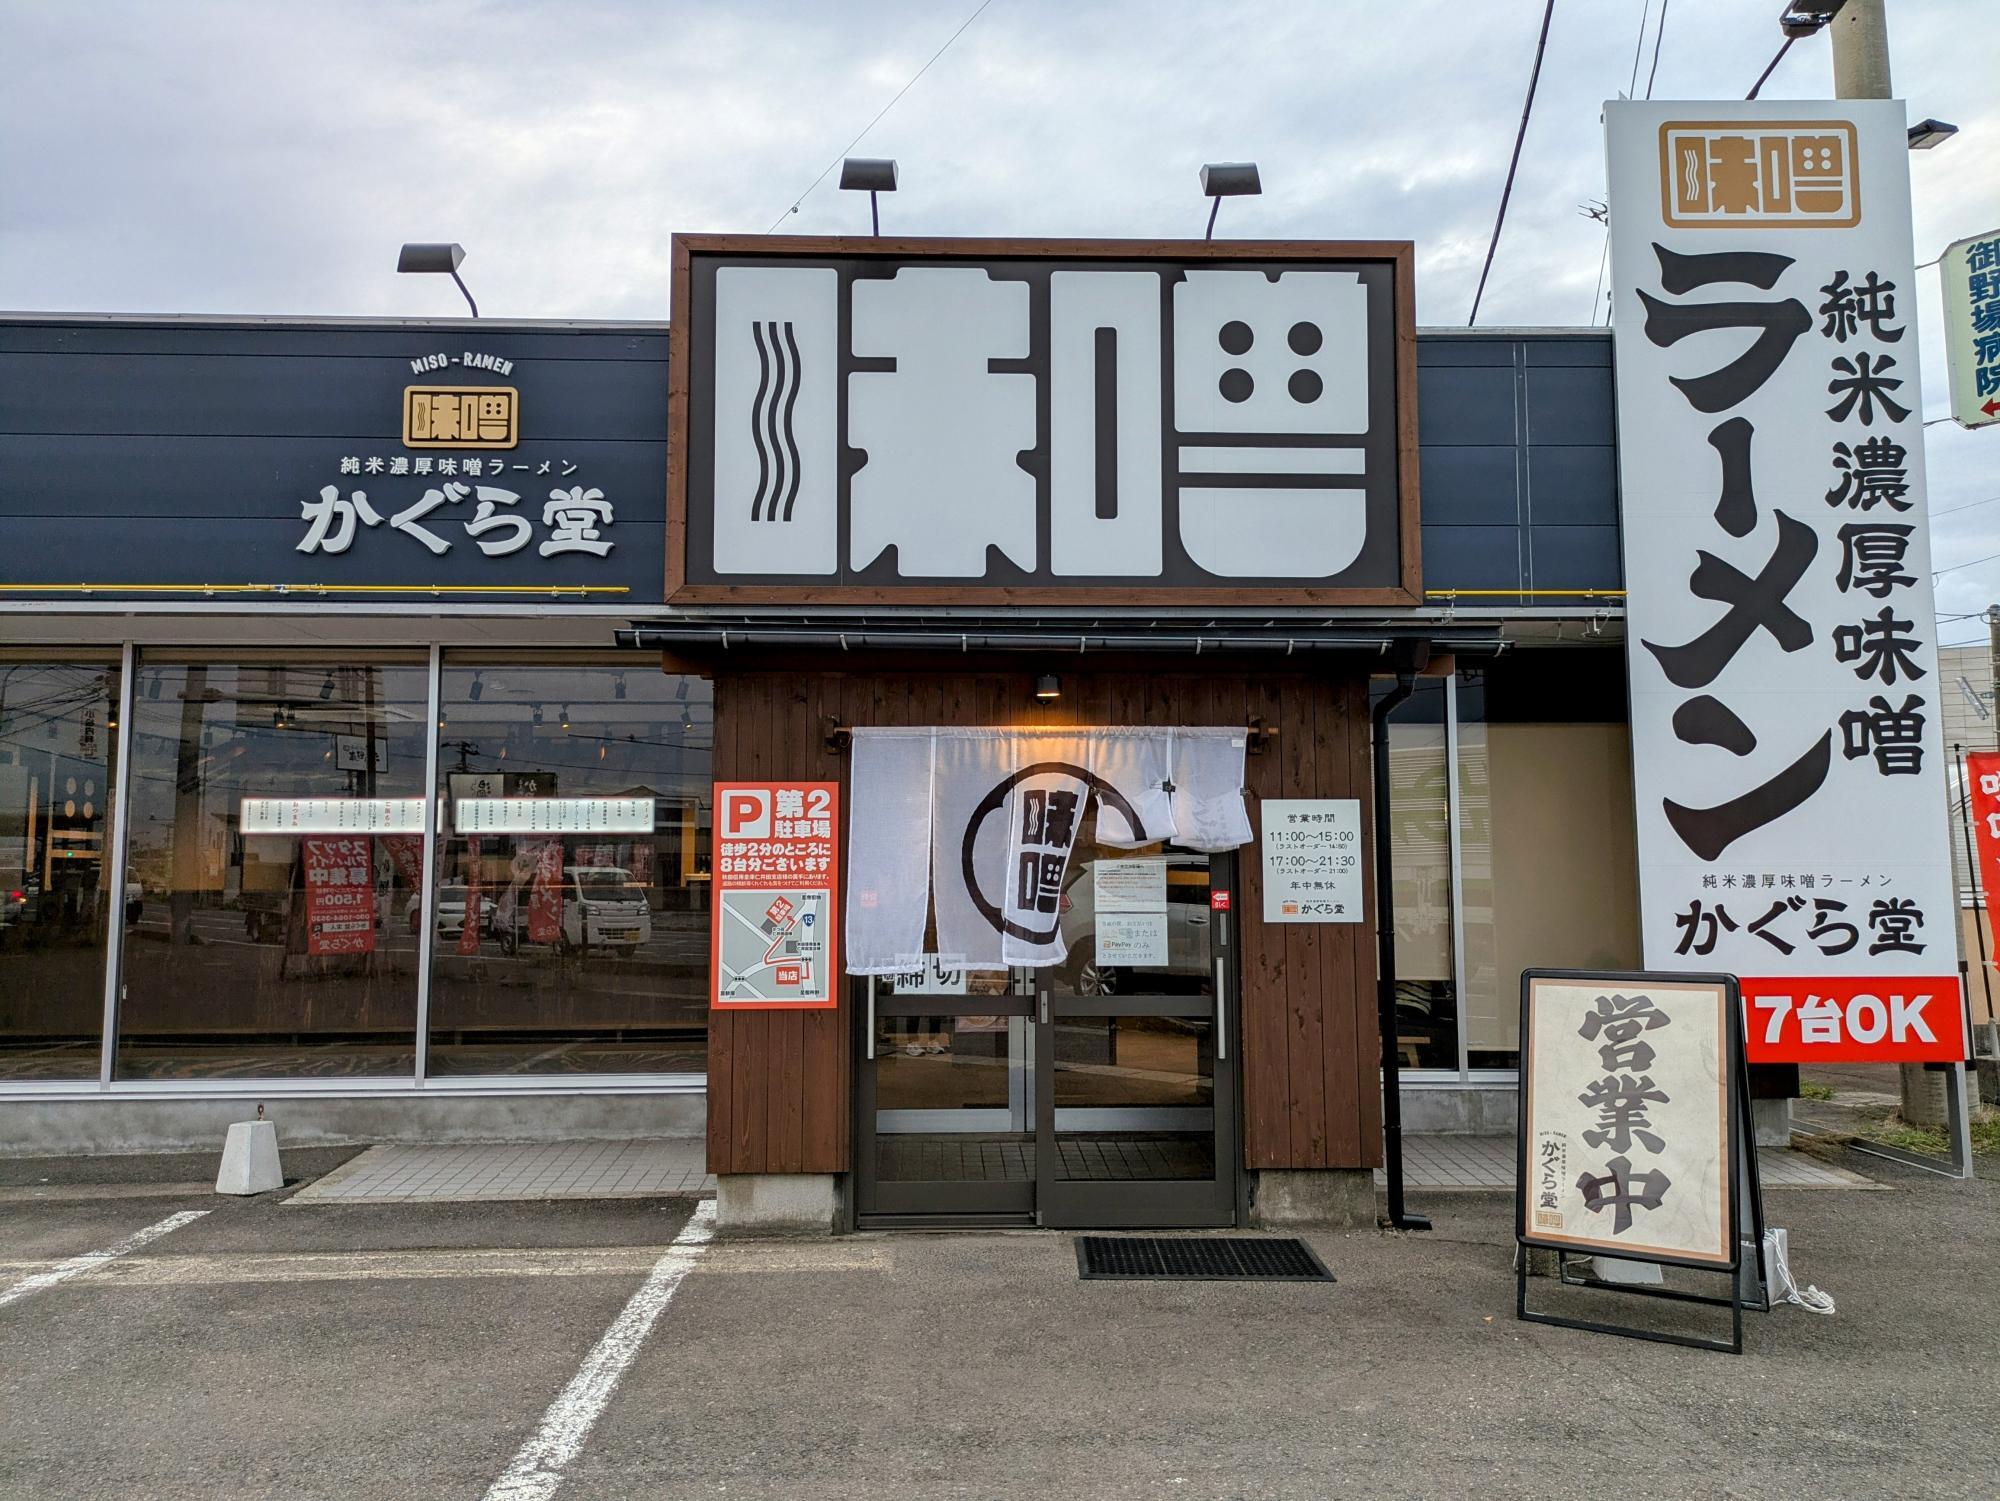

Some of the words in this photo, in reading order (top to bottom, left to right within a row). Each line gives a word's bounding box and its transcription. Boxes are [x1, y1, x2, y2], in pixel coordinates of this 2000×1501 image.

[713, 266, 1370, 579] 味噌
[340, 456, 578, 477] 純米濃厚味噌ラーメン
[295, 481, 615, 558] かぐら堂
[1818, 269, 1928, 777] 純米濃厚味噌
[1635, 240, 1832, 862] ラーメン
[775, 789, 831, 819] 第2
[1287, 813, 1335, 823] 営業時間
[774, 820, 831, 838] 駐車場
[720, 842, 831, 856] 徒歩2分のところに
[720, 857, 831, 872] 8台分ございます
[1289, 881, 1336, 890] 年中無休
[1702, 873, 1893, 889] 純米濃厚味噌ラーメン
[1301, 903, 1345, 915] かぐら堂
[804, 915, 813, 924] 13
[1673, 894, 1928, 957] かぐら堂
[778, 971, 798, 981] 当店
[1575, 994, 1672, 1235] 営業中
[1540, 1140, 1561, 1210] かぐら堂
